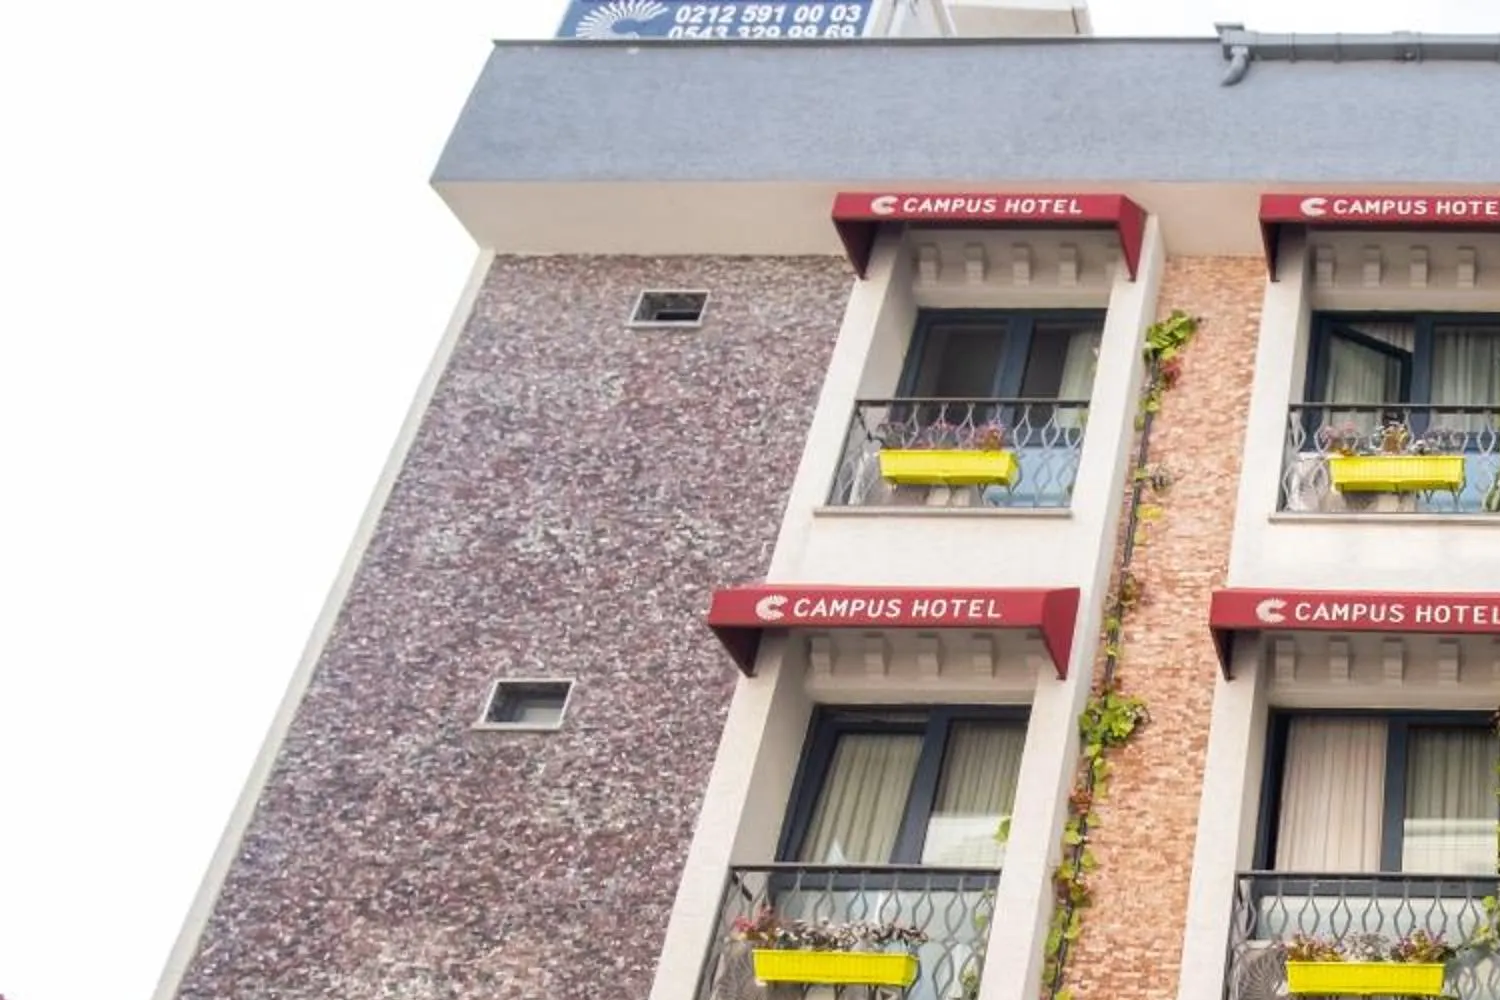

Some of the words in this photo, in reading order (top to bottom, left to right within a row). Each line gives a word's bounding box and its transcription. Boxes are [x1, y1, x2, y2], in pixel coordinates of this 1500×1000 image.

[675, 4, 737, 24] 0212
[741, 4, 787, 24] 591
[793, 4, 824, 24] 00
[830, 4, 862, 24] 03
[903, 198, 997, 213] CAMPUS
[1004, 199, 1082, 214] HOTEL
[1333, 199, 1428, 215] CAMPUS
[793, 598, 903, 617] CAMPUS
[911, 598, 1003, 618] HOTEL
[1295, 602, 1405, 623] CAMPUS
